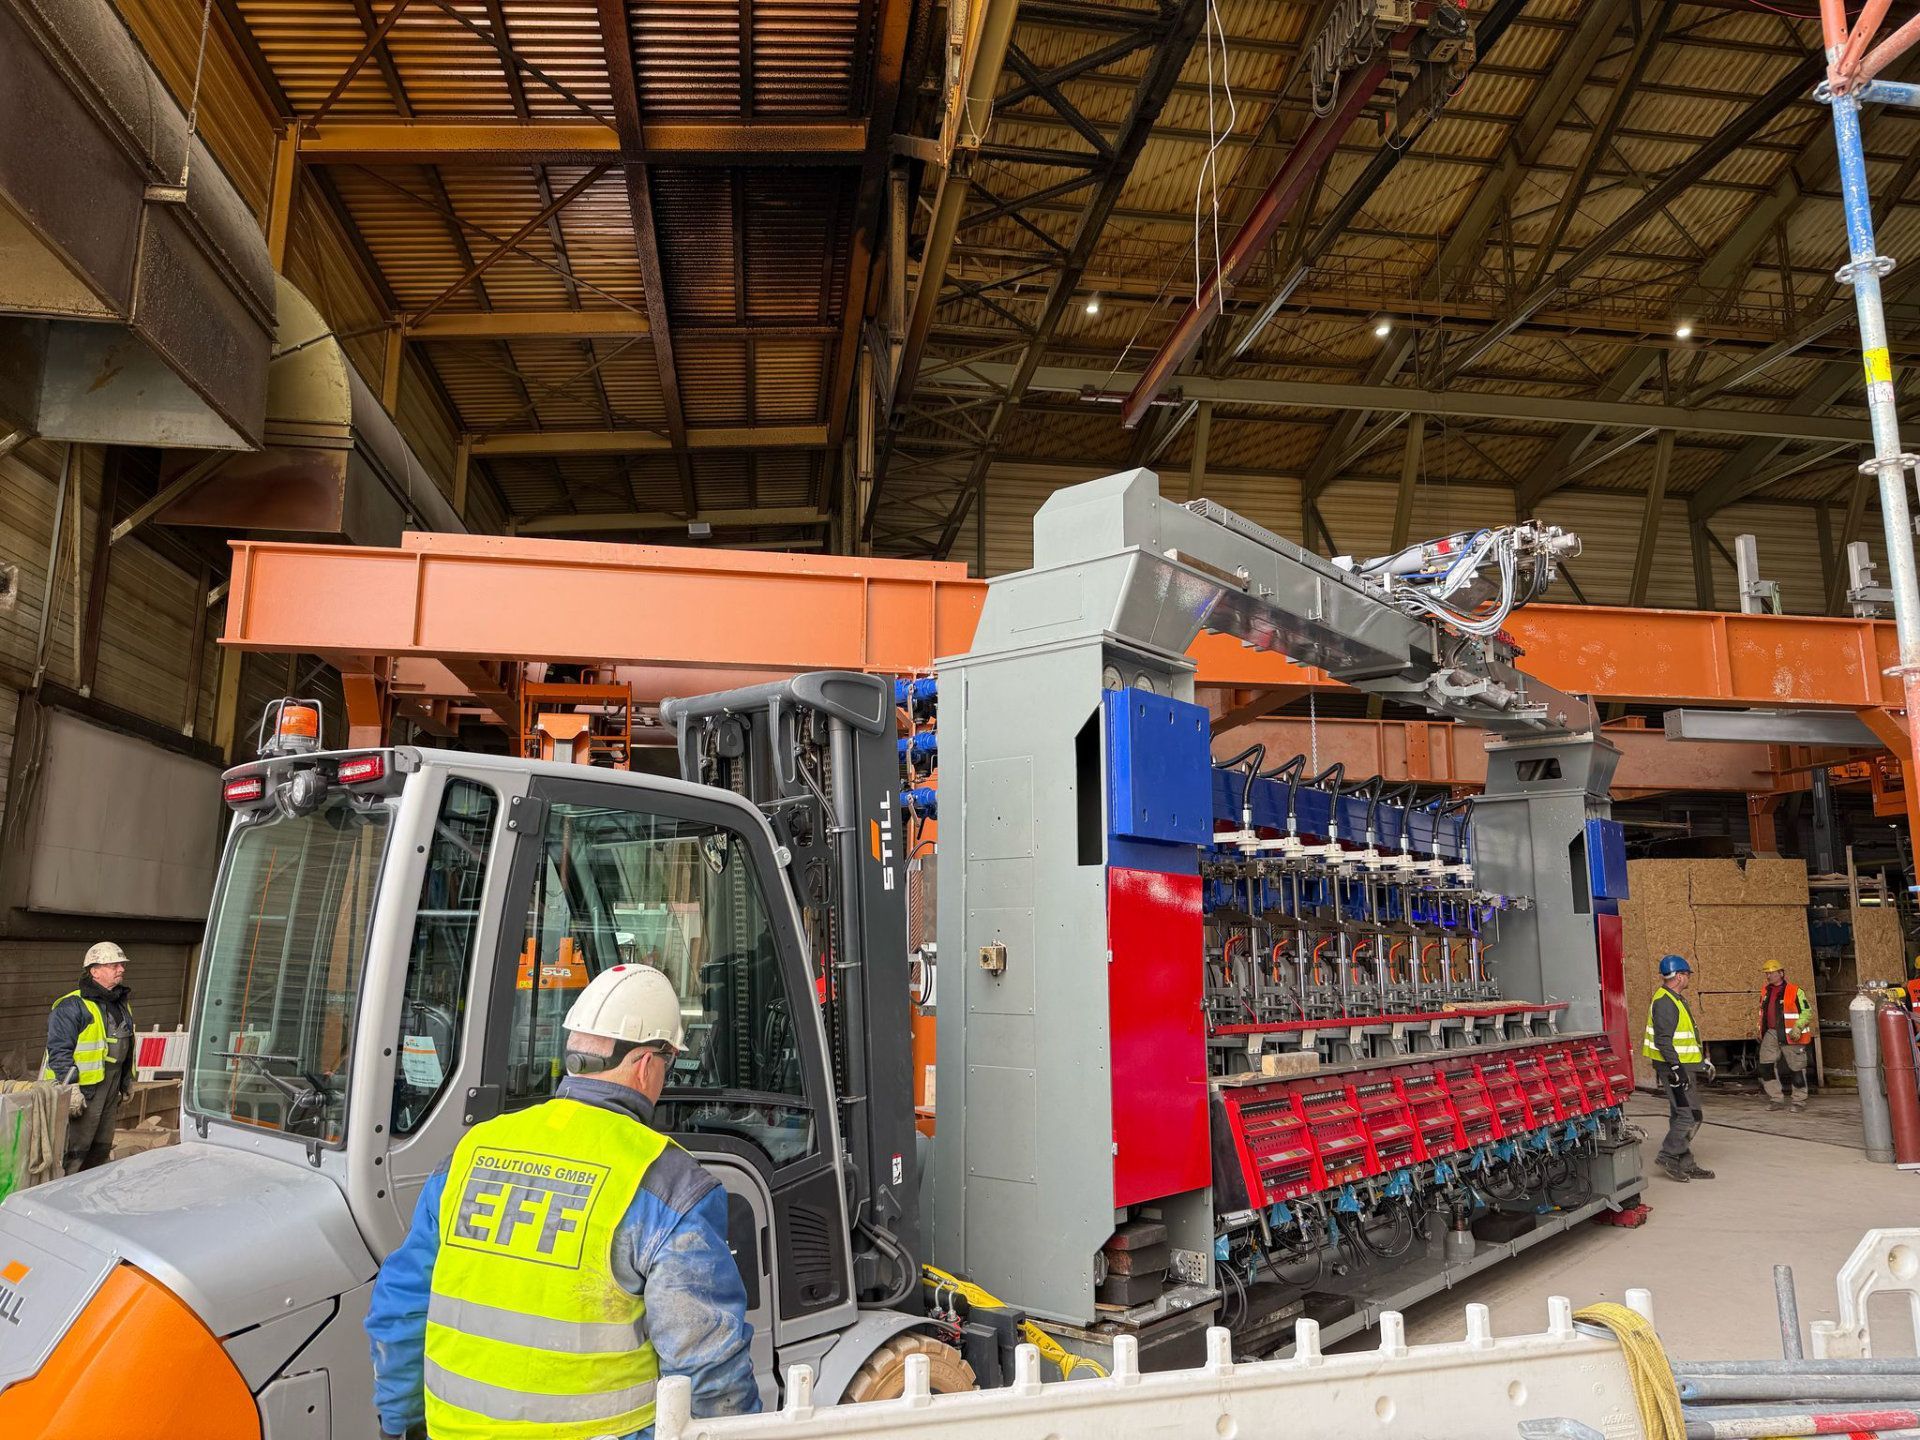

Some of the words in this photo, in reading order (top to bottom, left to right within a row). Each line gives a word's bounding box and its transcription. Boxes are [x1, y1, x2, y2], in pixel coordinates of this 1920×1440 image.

[880, 790, 894, 890] STILL
[475, 1155, 552, 1177] SOLUTIONS
[555, 1167, 598, 1185] GMBH
[454, 1179, 588, 1254] EFF
[0, 1285, 25, 1327] ILL
